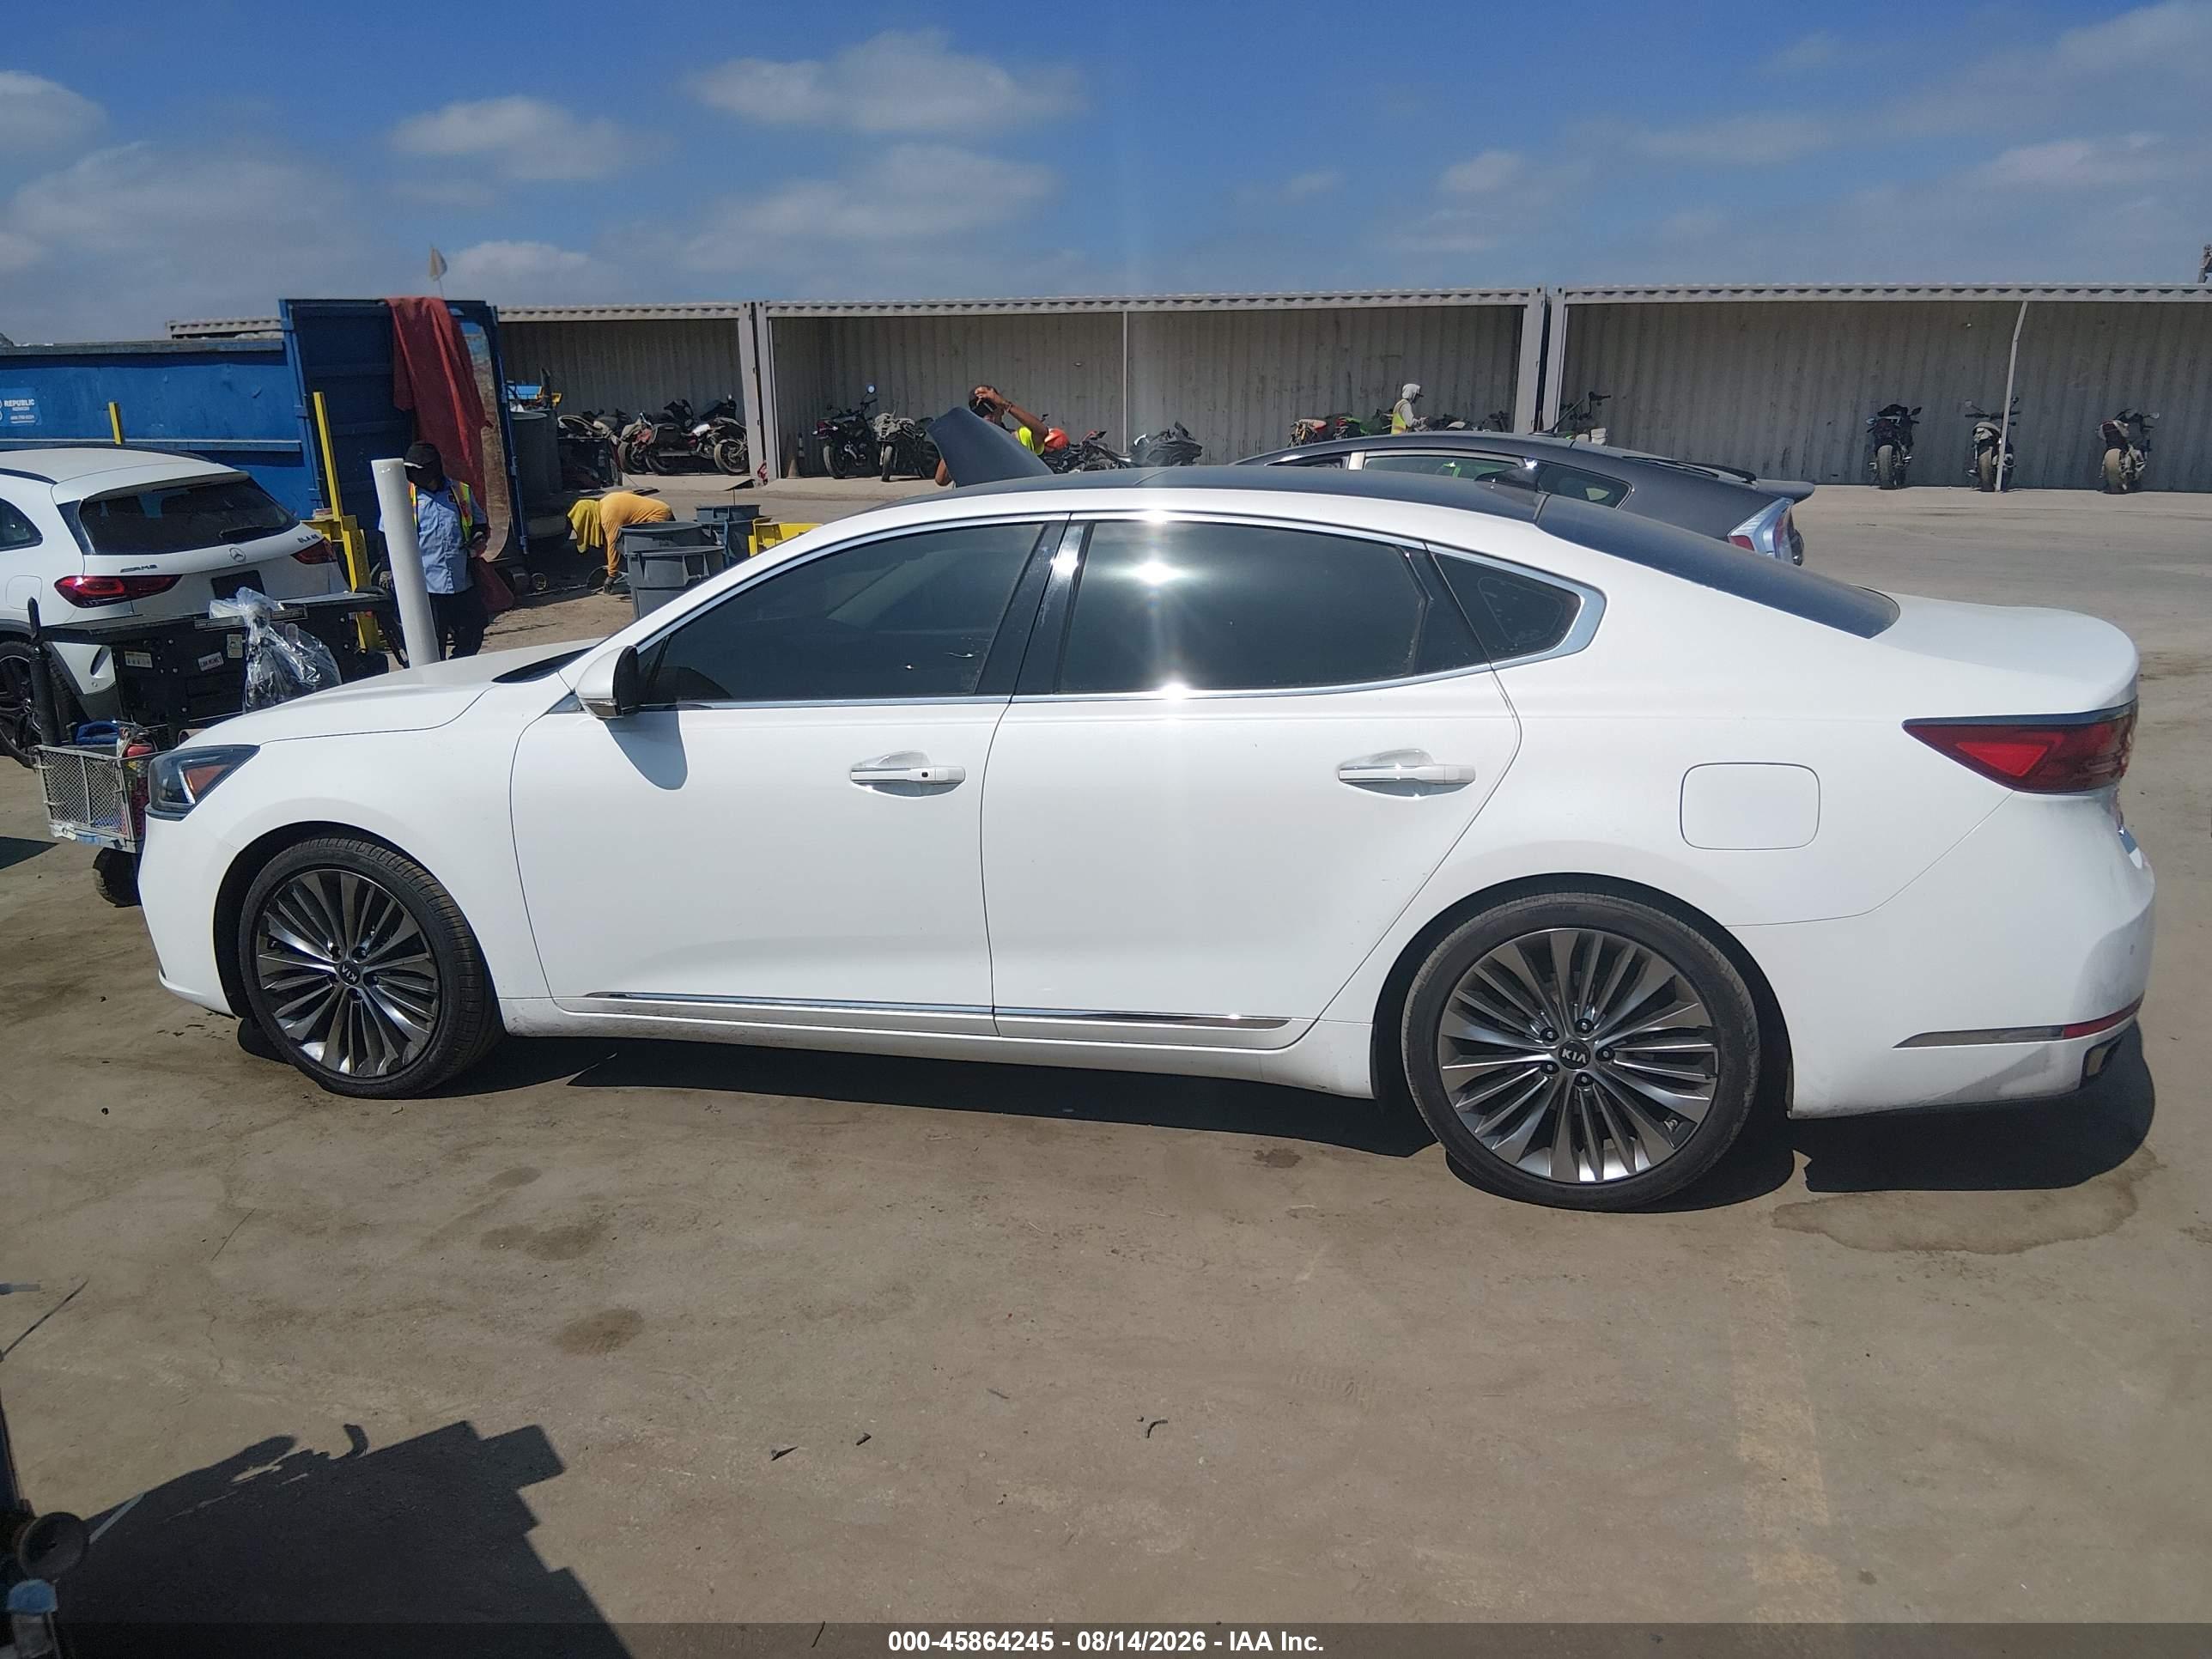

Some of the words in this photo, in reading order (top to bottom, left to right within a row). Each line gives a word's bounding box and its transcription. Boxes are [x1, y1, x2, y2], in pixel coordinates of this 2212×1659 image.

[3, 398, 35, 407] REPUBLIC
[342, 964, 357, 982] KIA
[1561, 1048, 1587, 1064] KIA
